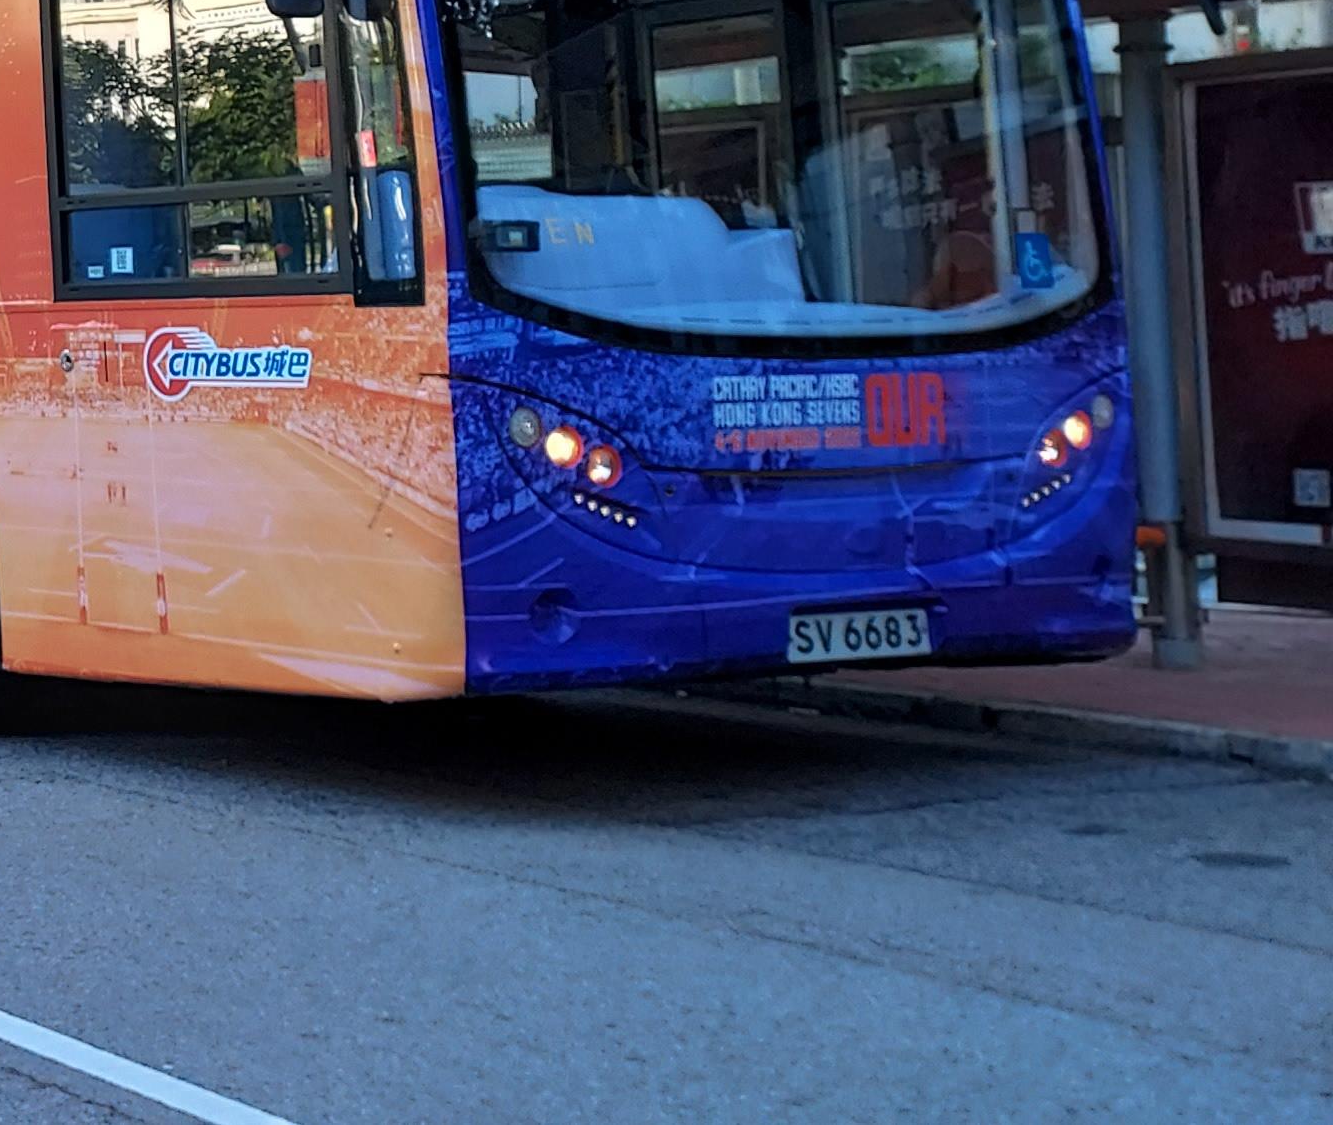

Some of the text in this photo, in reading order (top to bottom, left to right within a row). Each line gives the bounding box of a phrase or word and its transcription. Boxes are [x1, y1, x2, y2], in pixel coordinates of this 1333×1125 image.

[168, 349, 310, 378] CITYBUS 城巴
[713, 376, 767, 401] CATHAY
[714, 399, 860, 427] HONG KONG SEVENS
[794, 614, 922, 653] SV 6683
